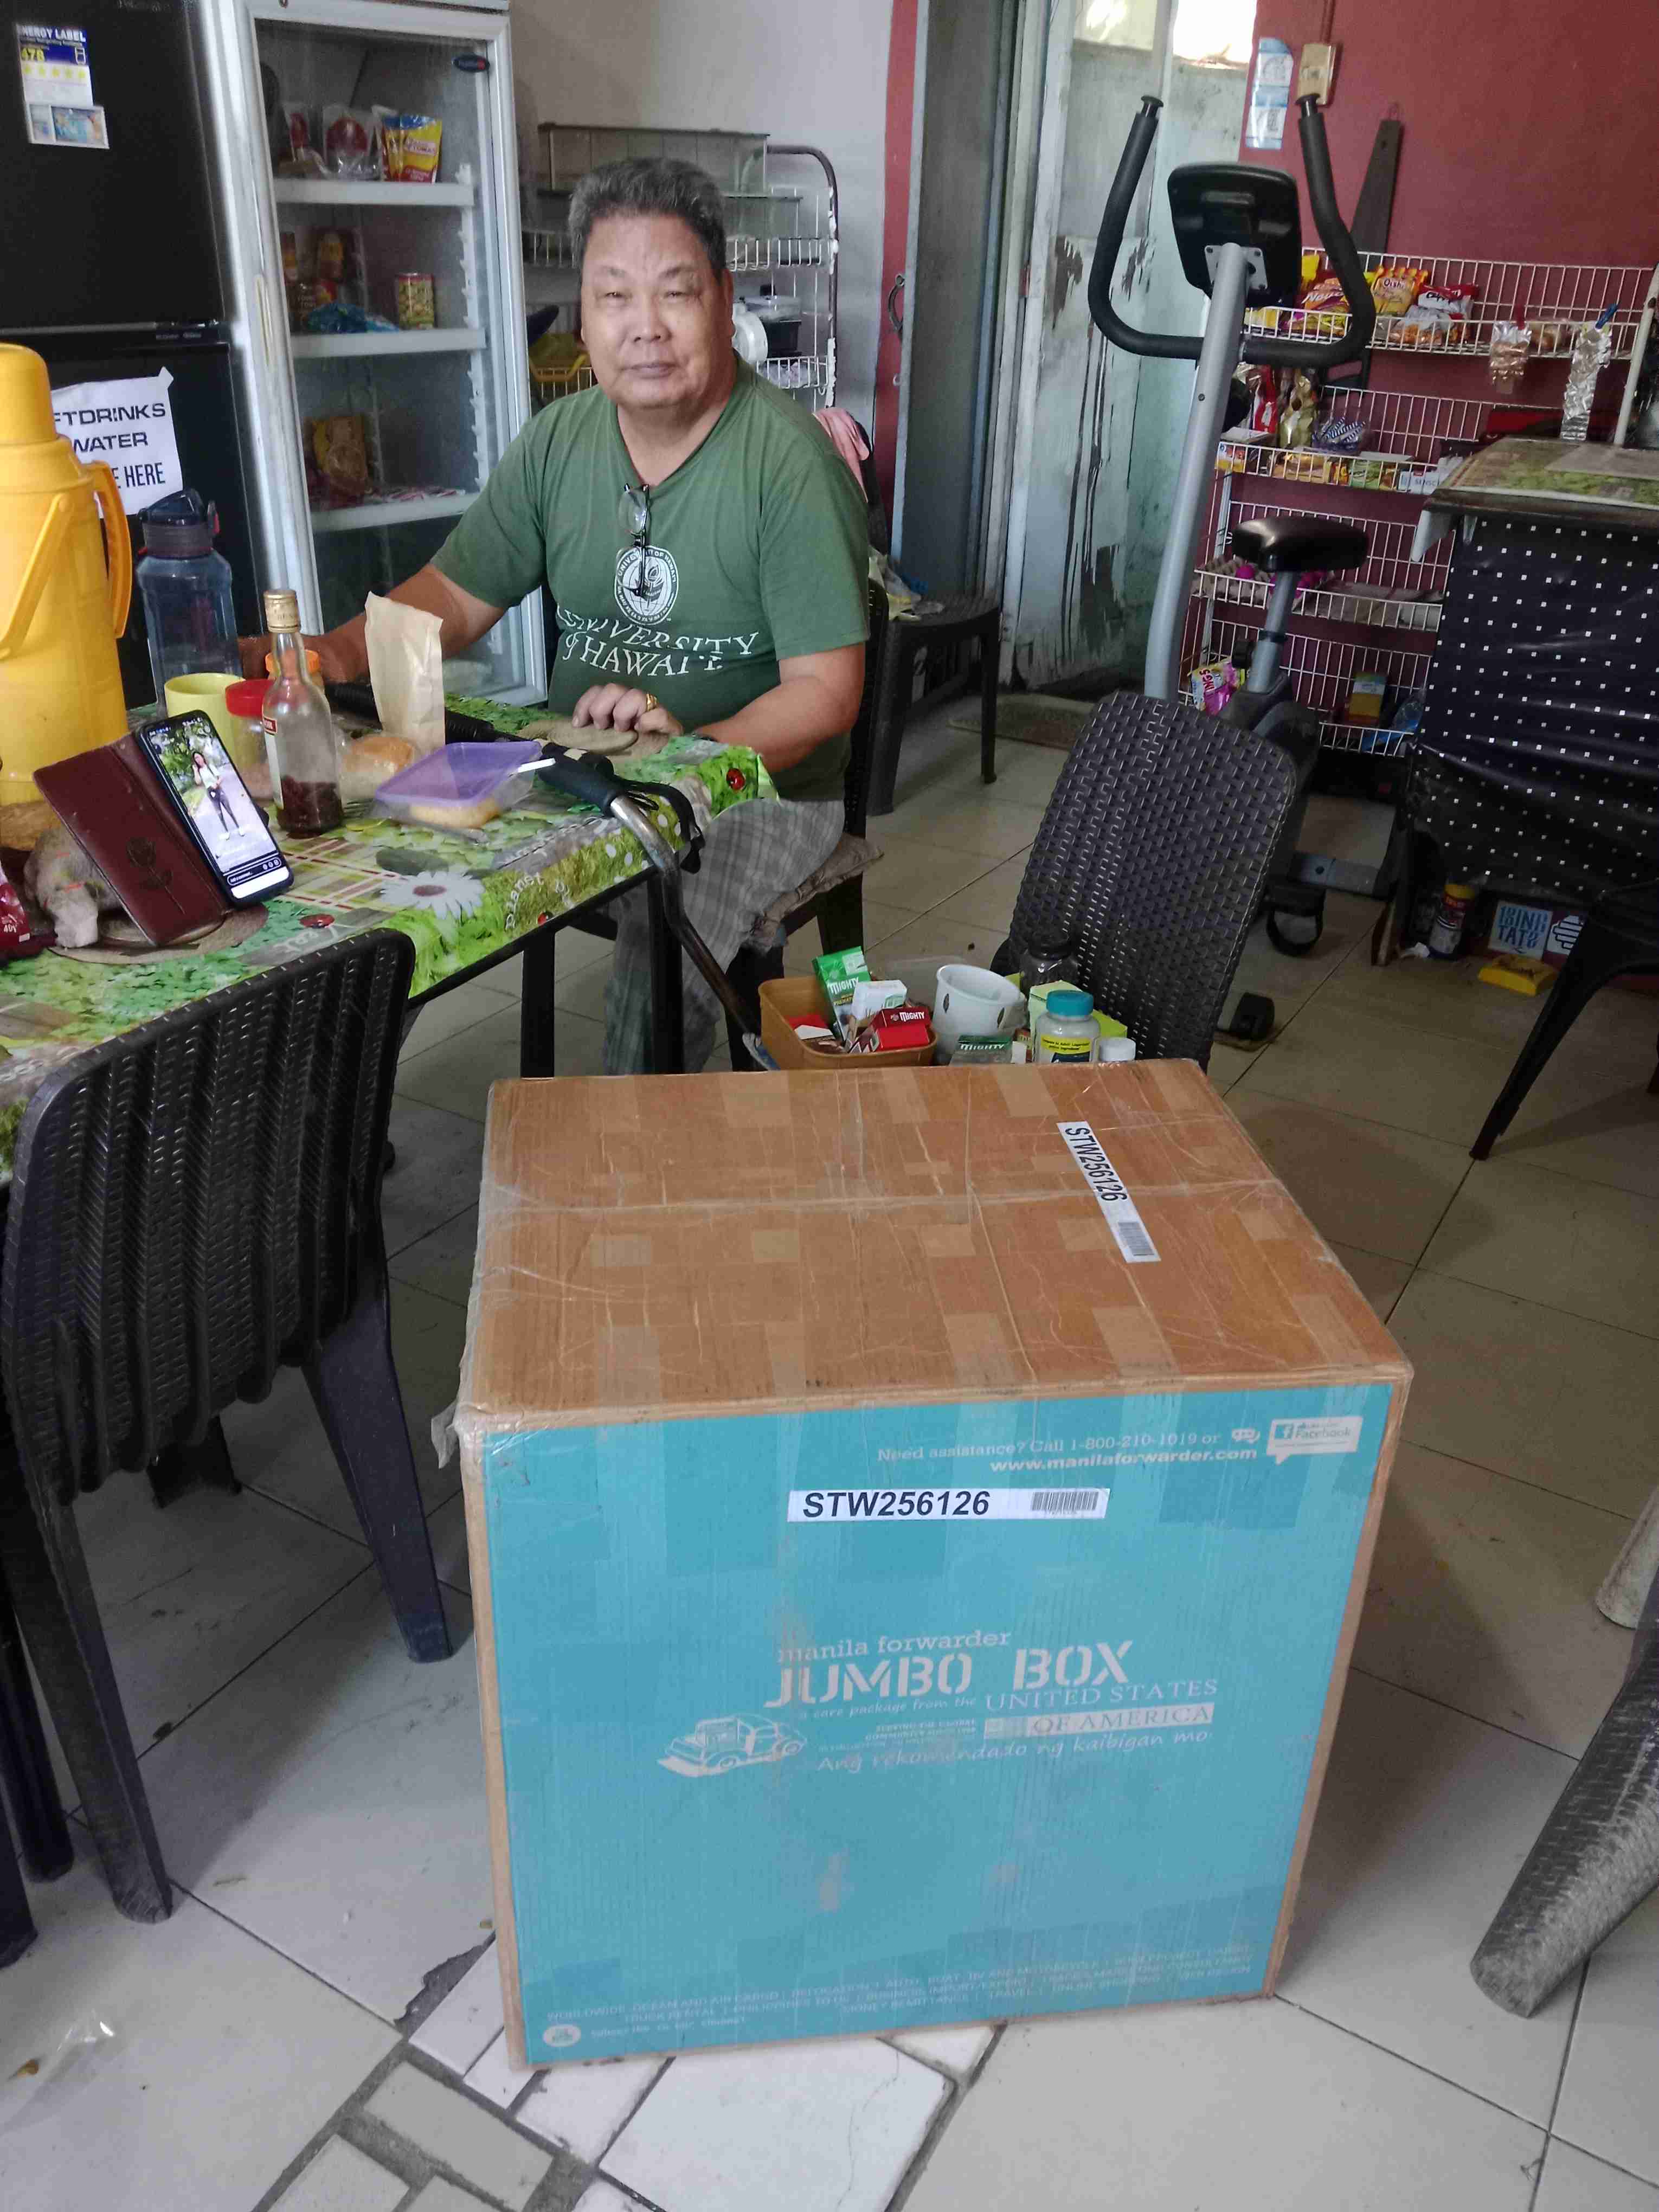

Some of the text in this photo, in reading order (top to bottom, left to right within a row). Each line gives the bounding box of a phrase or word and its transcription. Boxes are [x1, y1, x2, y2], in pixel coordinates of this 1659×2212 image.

[55, 28, 86, 42] LABEL
[124, 462, 165, 488] HERE
[556, 603, 759, 655] UNIVERSITY
[828, 977, 859, 994] MIGHTY
[899, 1012, 924, 1022] MIGHTY
[1065, 1128, 1127, 1201] STW256126
[877, 1447, 924, 1462] Need
[1030, 1439, 1063, 1453] Call
[990, 1449, 1257, 1472] www.manilaforwarder.com
[803, 1491, 990, 1518] STW256126
[778, 1630, 1012, 1663] manila forwarder
[763, 1640, 1133, 1708] JUMBO BOX
[850, 1702, 907, 1718] package
[913, 1698, 949, 1711] from
[955, 1696, 975, 1707] the
[985, 1686, 1101, 1711] UNITED
[1110, 1679, 1218, 1703] STATES
[1079, 1706, 1211, 1730] AMERICA
[1073, 1732, 1163, 1752] kaibigan
